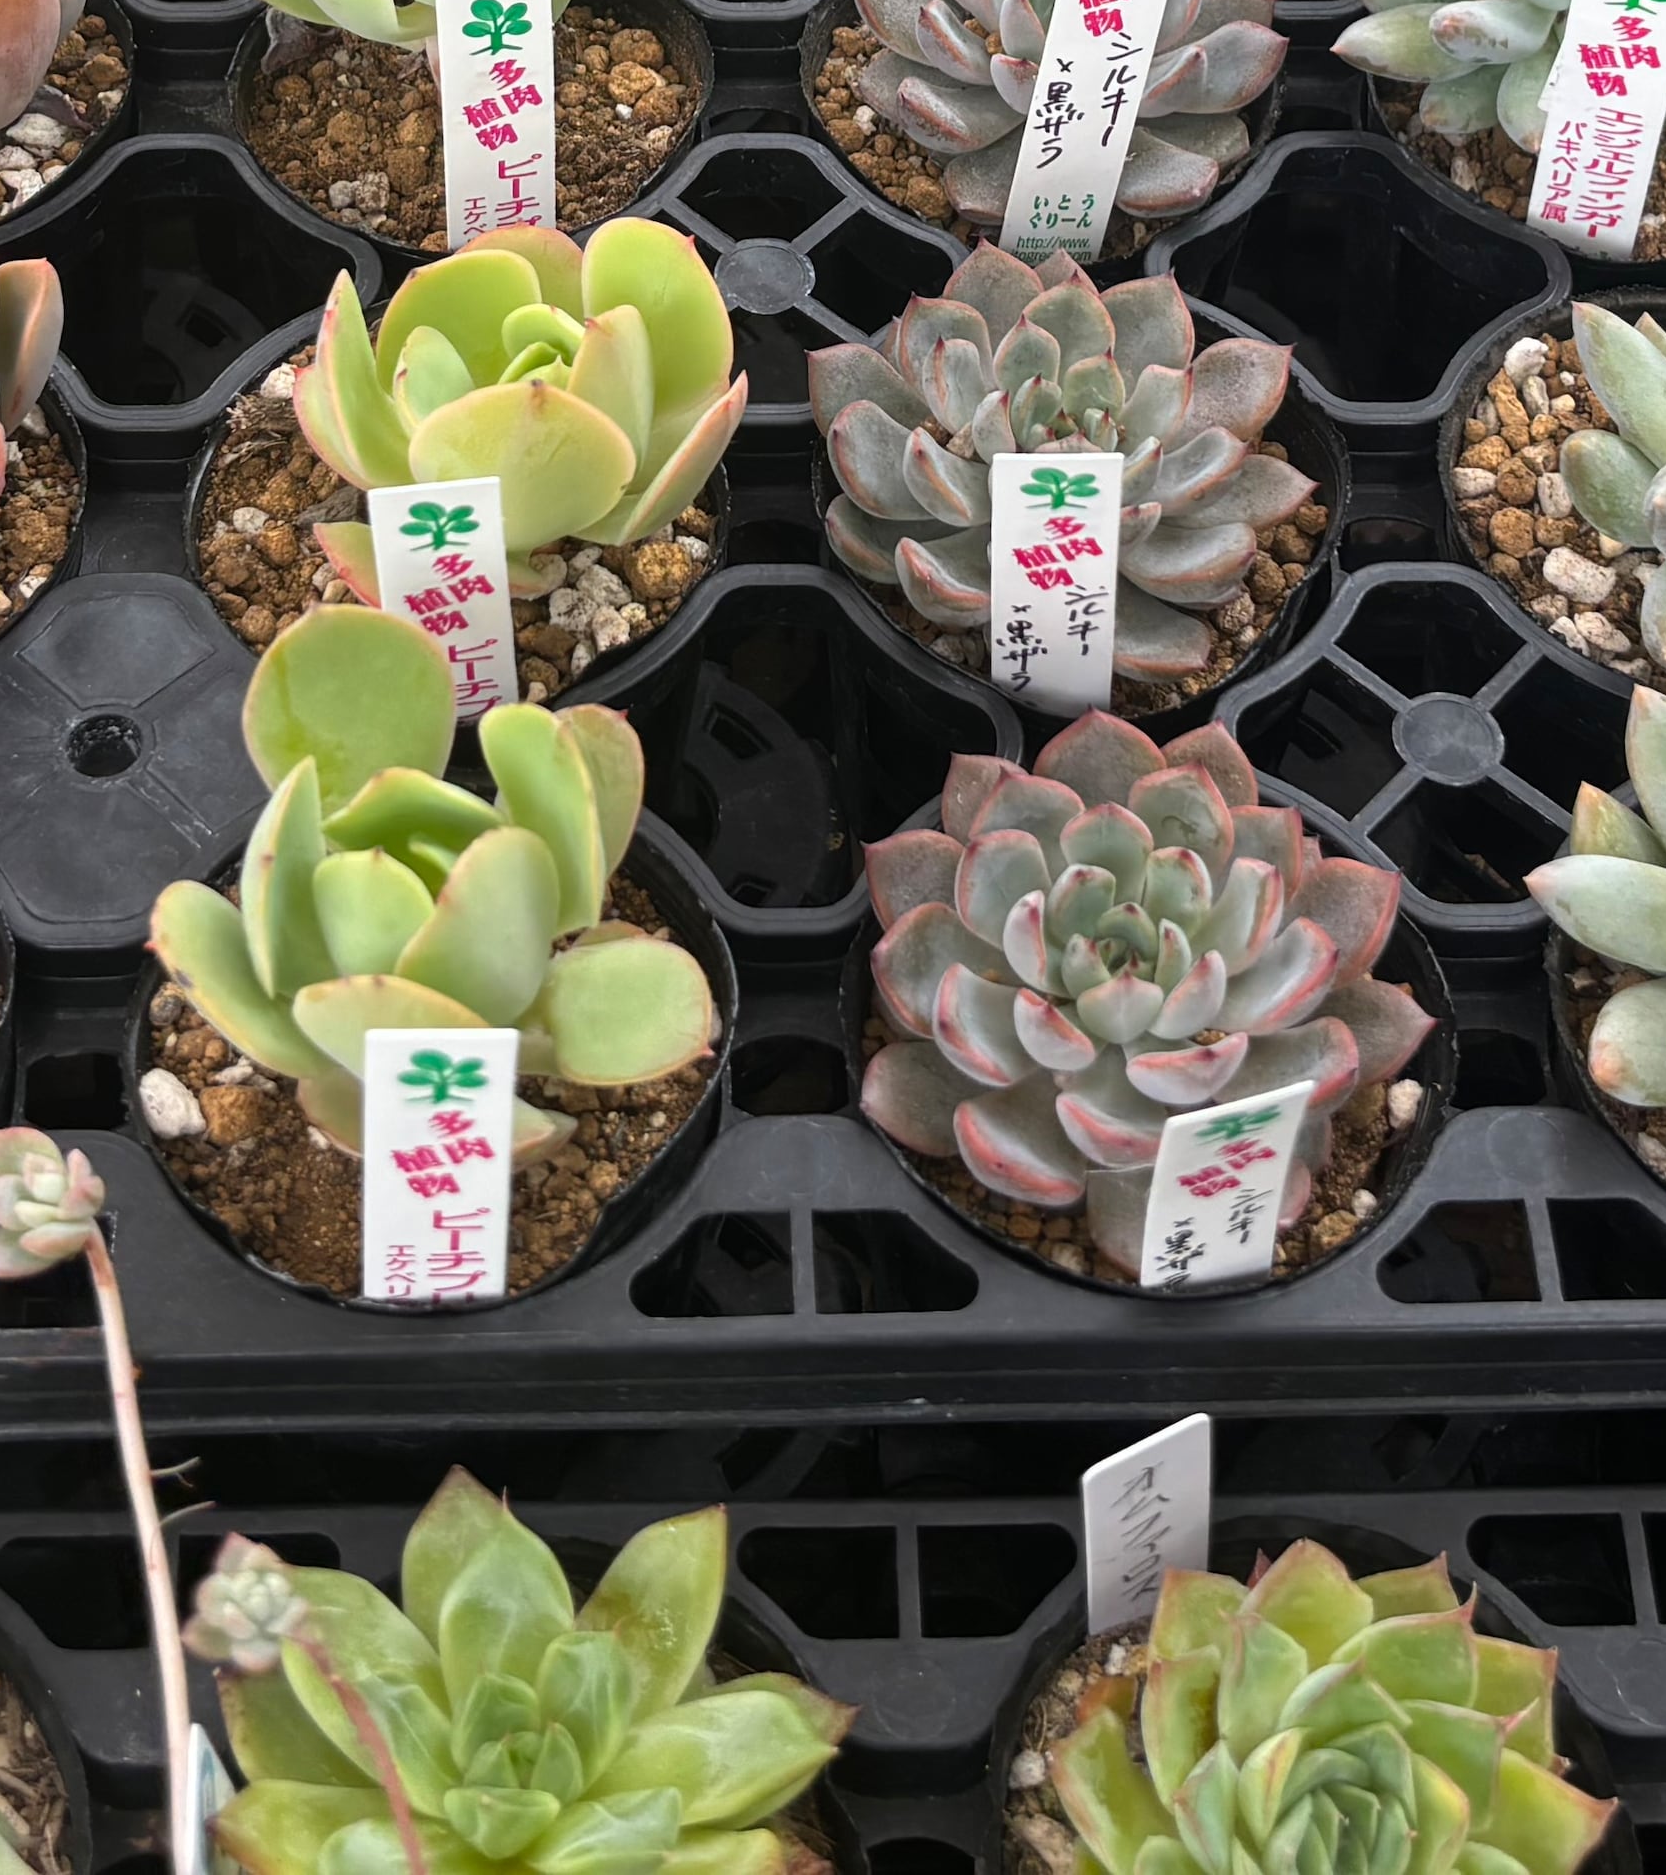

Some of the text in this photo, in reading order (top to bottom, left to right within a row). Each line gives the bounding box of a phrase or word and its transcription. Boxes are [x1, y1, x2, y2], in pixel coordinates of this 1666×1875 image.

[1100, 32, 1144, 148] シルキー
[1580, 17, 1661, 97] 多肉植物
[462, 59, 543, 151] 多肉植物
[495, 153, 543, 228] ピーチ
[1033, 193, 1095, 211] いとう
[1540, 118, 1589, 224] パキベリア属
[1029, 212, 1093, 229] ぐりーん
[1014, 517, 1104, 591] 多肉植物
[404, 554, 495, 636] 多肉植物
[1064, 584, 1109, 656] シルキー
[393, 1112, 494, 1198] 多肉植物
